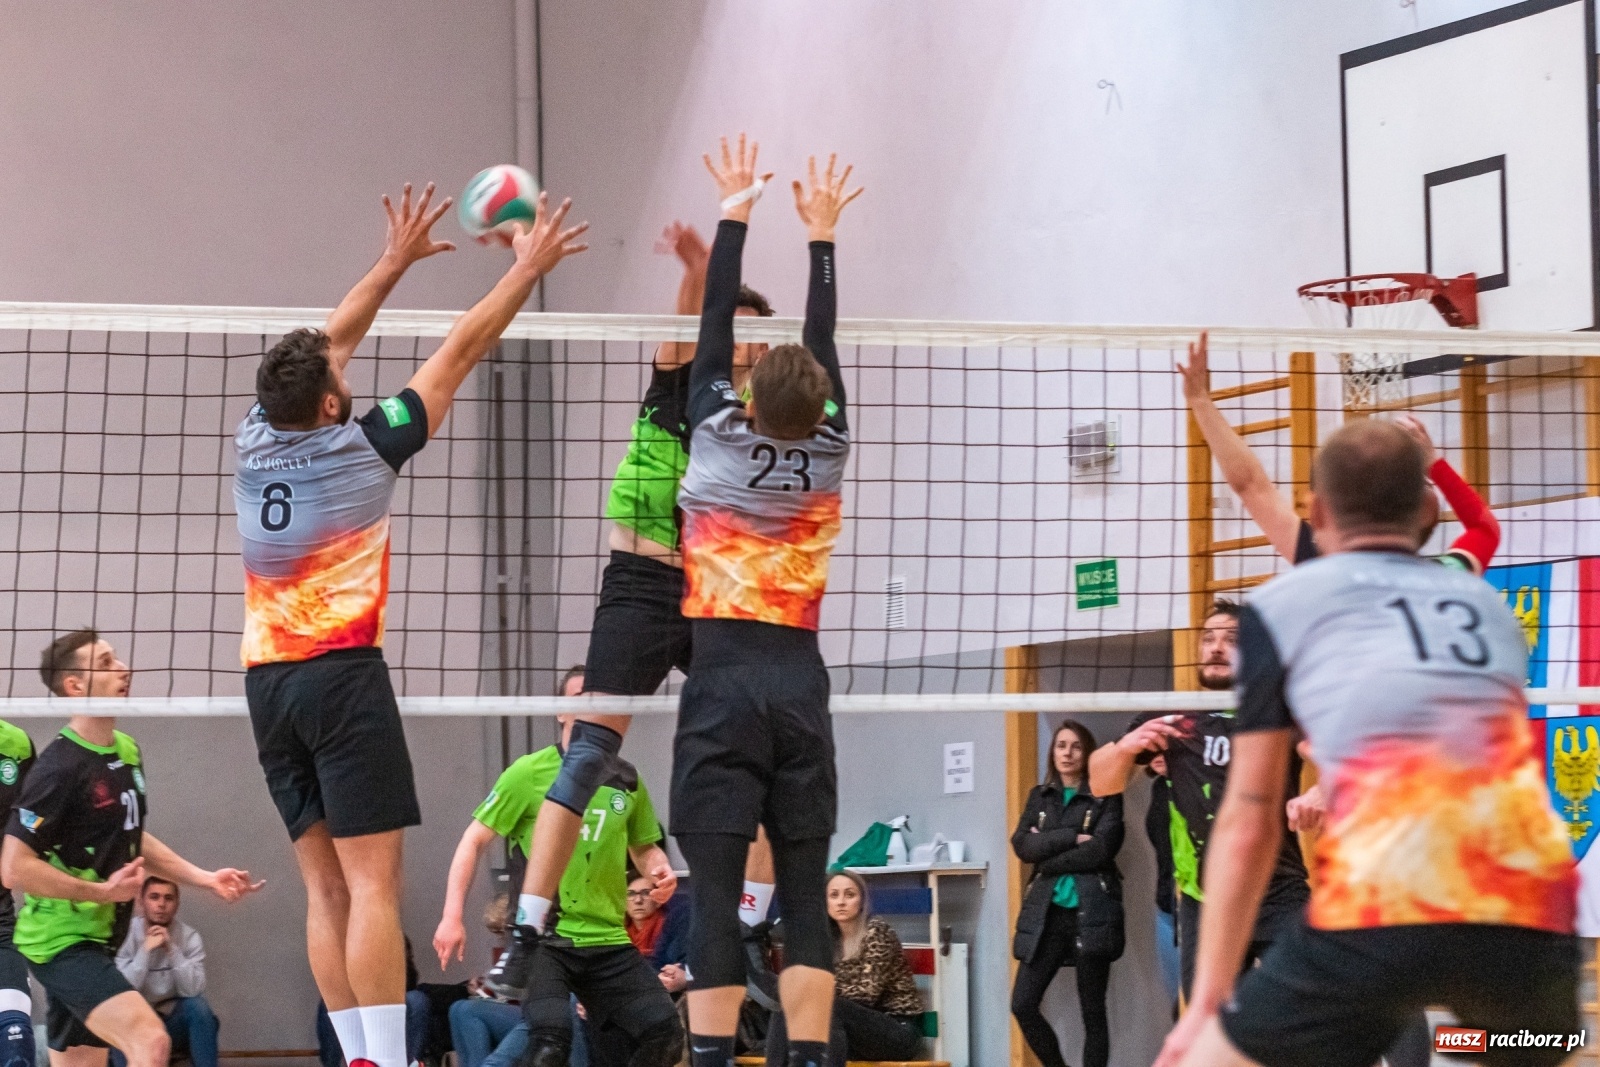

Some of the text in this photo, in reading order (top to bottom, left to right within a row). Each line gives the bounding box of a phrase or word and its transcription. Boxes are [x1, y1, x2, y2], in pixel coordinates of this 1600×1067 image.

[748, 442, 812, 491] 23
[261, 481, 292, 532] 8
[1384, 597, 1490, 667] 13
[1203, 735, 1230, 766] 10
[121, 789, 139, 830] 21
